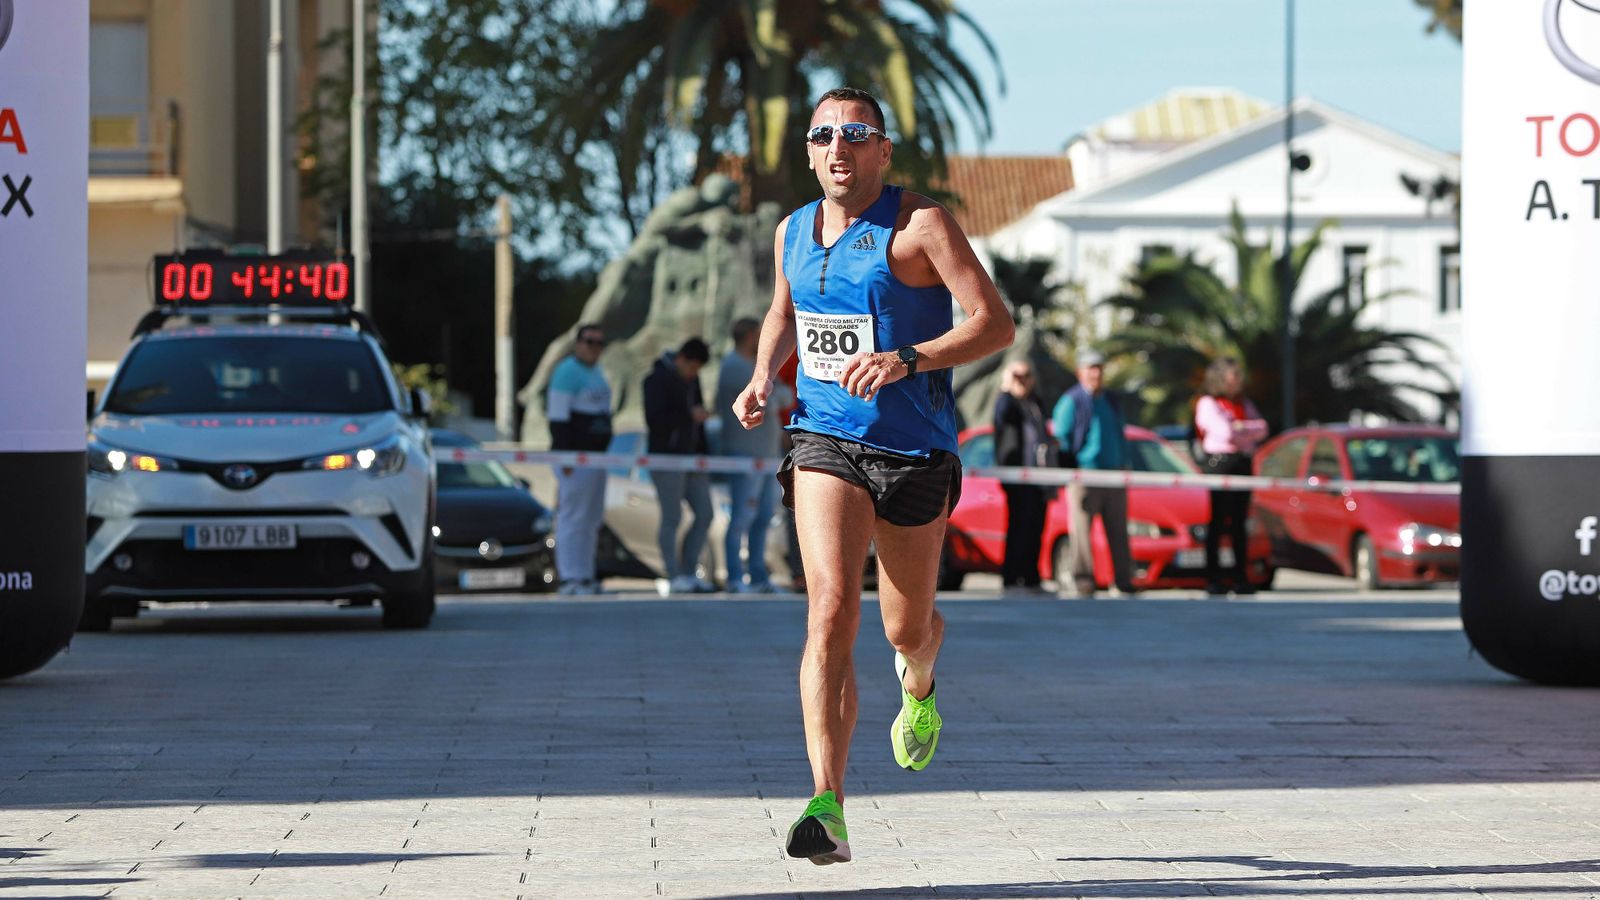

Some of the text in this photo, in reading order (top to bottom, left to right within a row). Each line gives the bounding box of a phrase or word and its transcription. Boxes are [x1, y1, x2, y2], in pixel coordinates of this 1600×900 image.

[0, 107, 28, 154] A
[1525, 113, 1600, 157] TO
[0, 173, 34, 218] X
[1525, 180, 1569, 221] A.
[850, 243, 877, 251] adidas
[162, 262, 349, 300] 00 44:40
[806, 328, 860, 355] 280
[199, 525, 246, 545] 9107
[1539, 569, 1600, 601] @to
